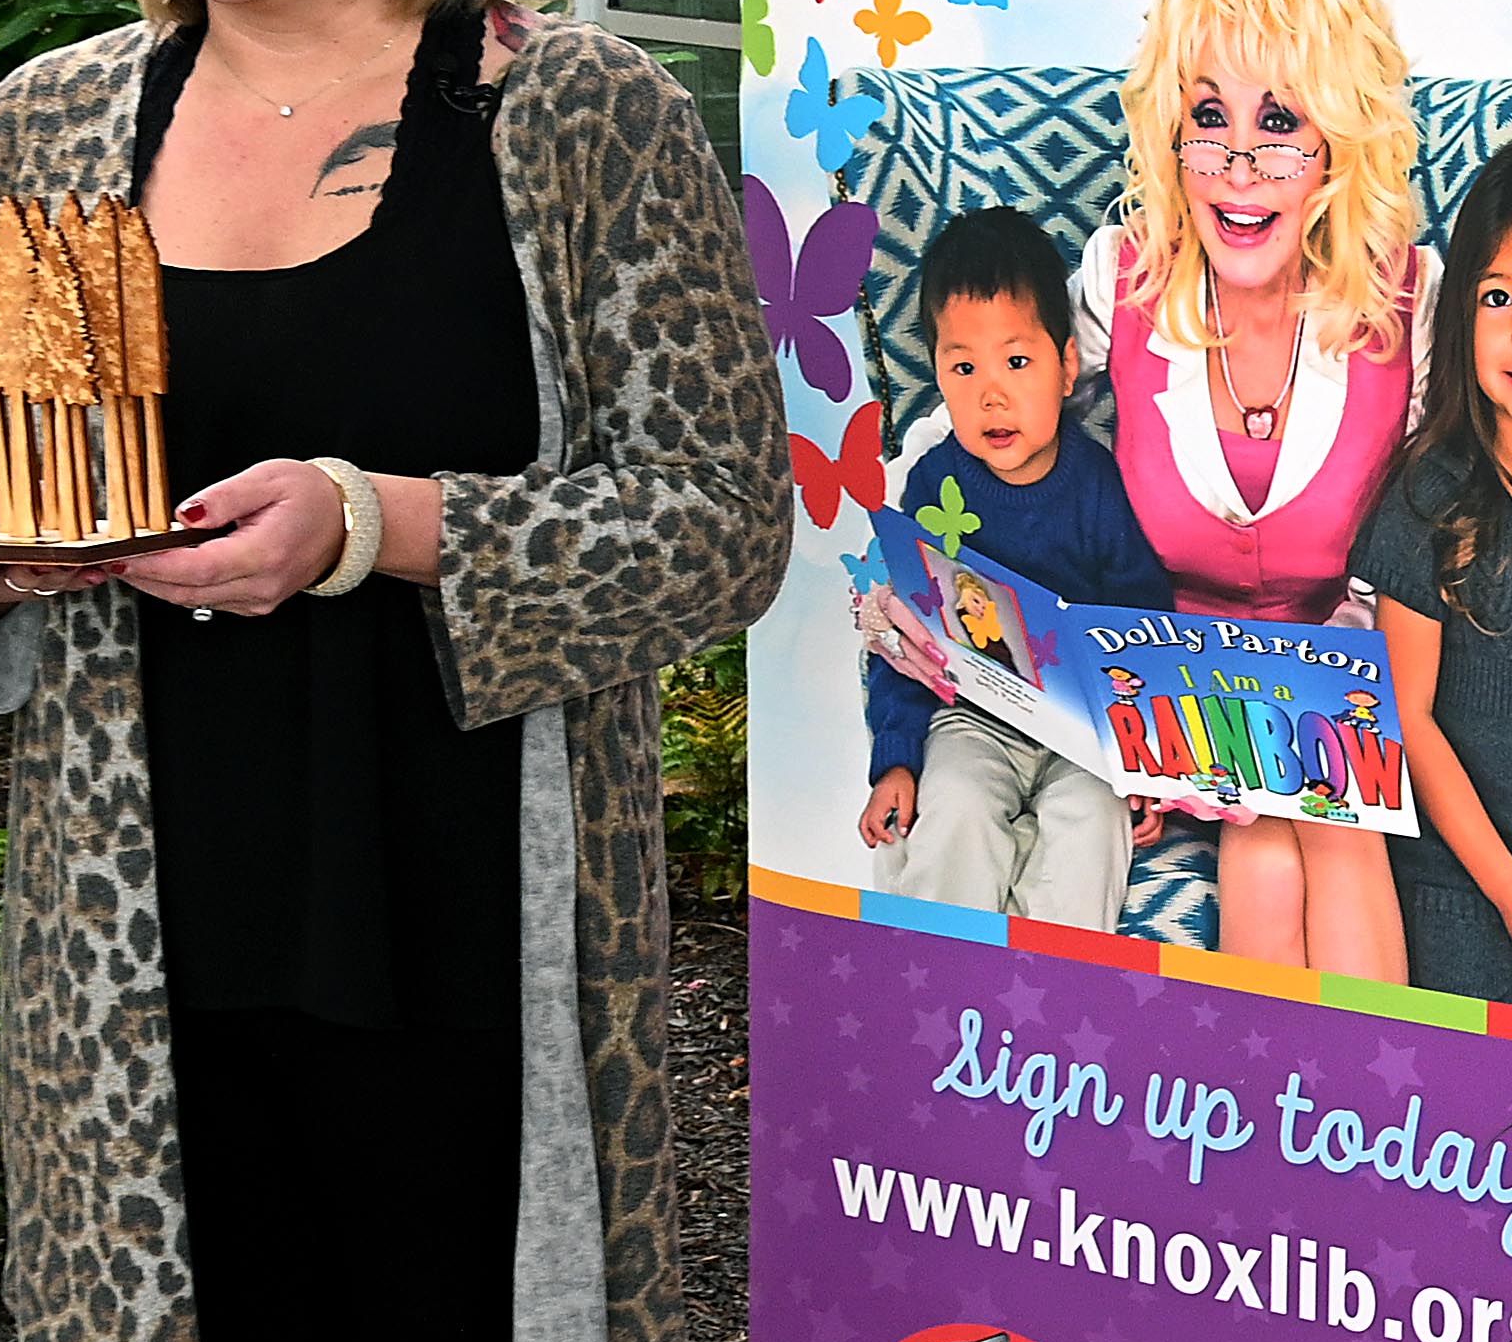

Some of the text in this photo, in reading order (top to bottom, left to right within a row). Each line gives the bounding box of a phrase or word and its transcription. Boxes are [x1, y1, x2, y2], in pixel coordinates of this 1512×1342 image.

[1086, 616, 1381, 683] Dolly Parton
[1178, 664, 1294, 702] I Am a
[1107, 694, 1402, 810] RAINBOW
[931, 1008, 1122, 1158] Sign
[1144, 1073, 1255, 1184] up
